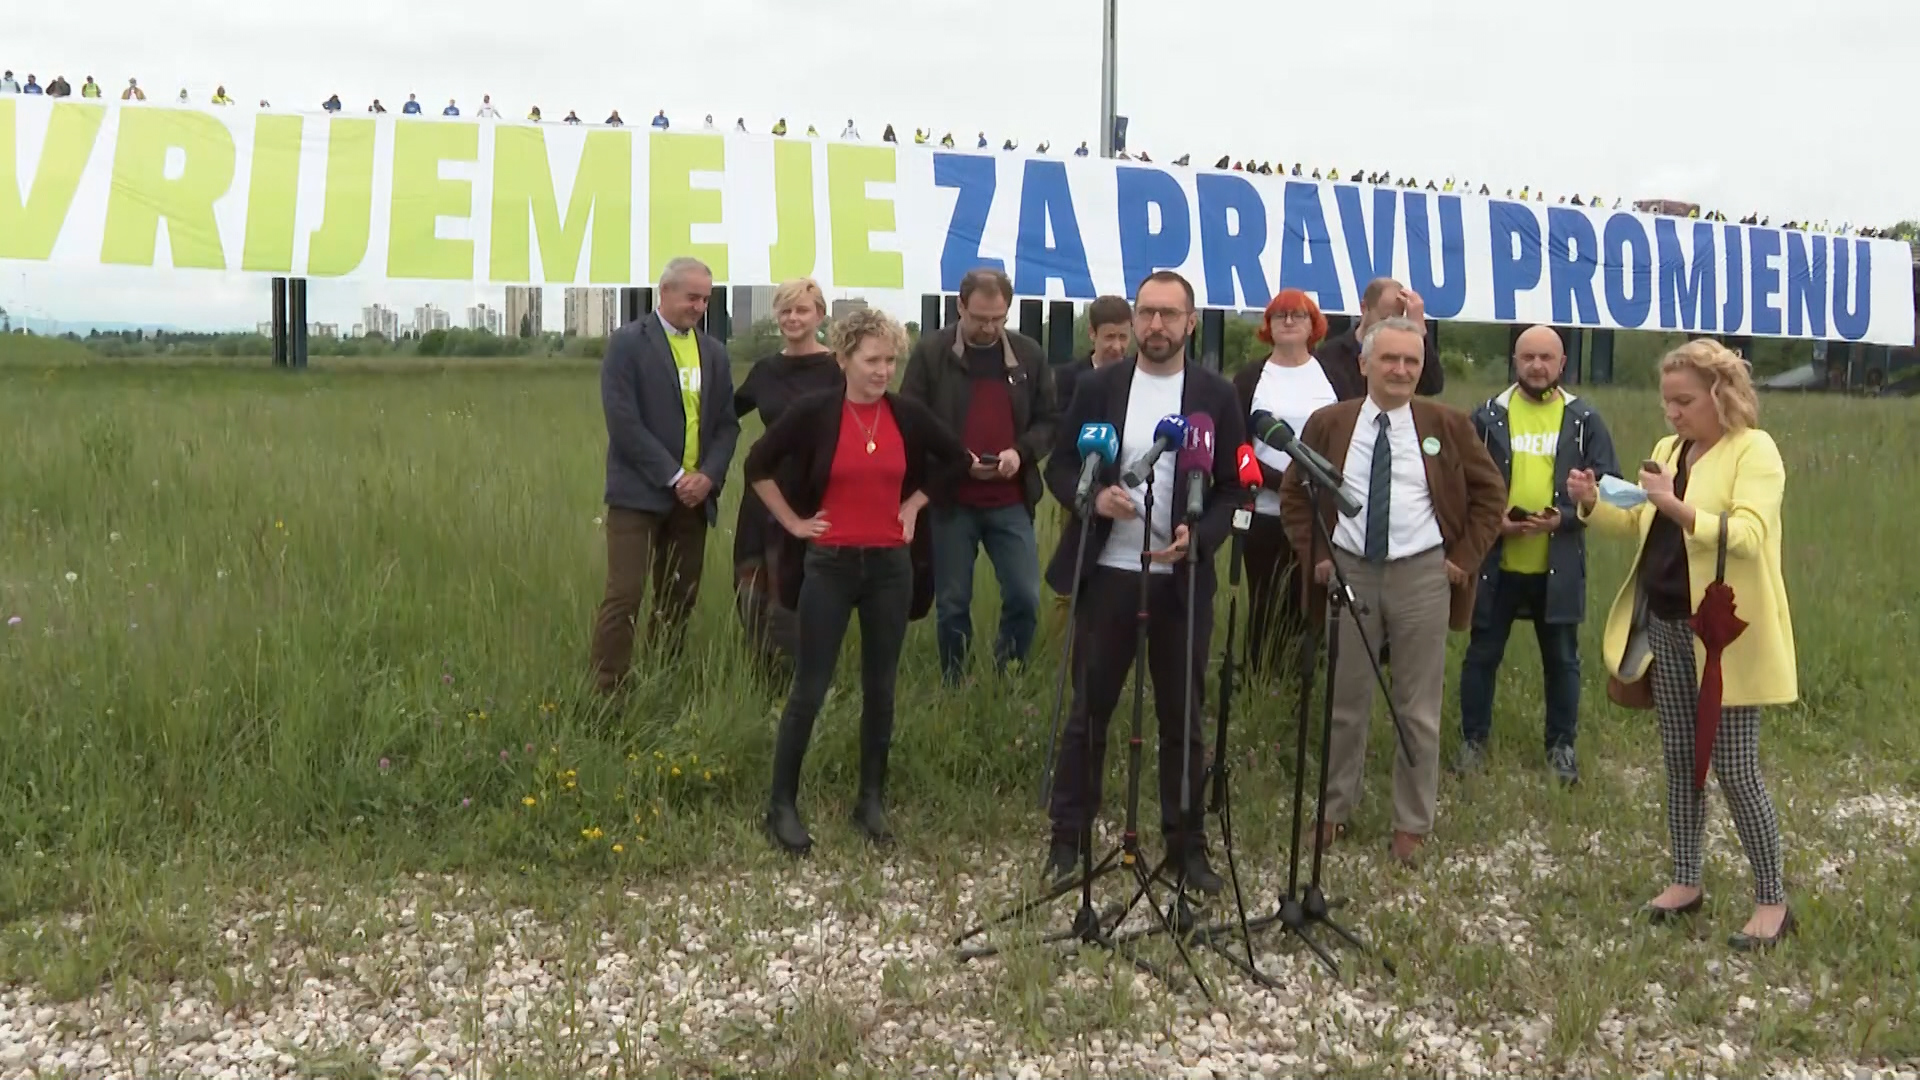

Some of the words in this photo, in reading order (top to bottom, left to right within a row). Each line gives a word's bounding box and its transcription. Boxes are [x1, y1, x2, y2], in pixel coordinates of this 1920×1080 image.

[0, 98, 729, 284] VRIJEME
[769, 140, 904, 289] JE
[933, 155, 1096, 300] ZA
[1116, 168, 1466, 319] PRAVU
[1489, 203, 1872, 341] PROMJENU
[1082, 426, 1108, 440] Z1
